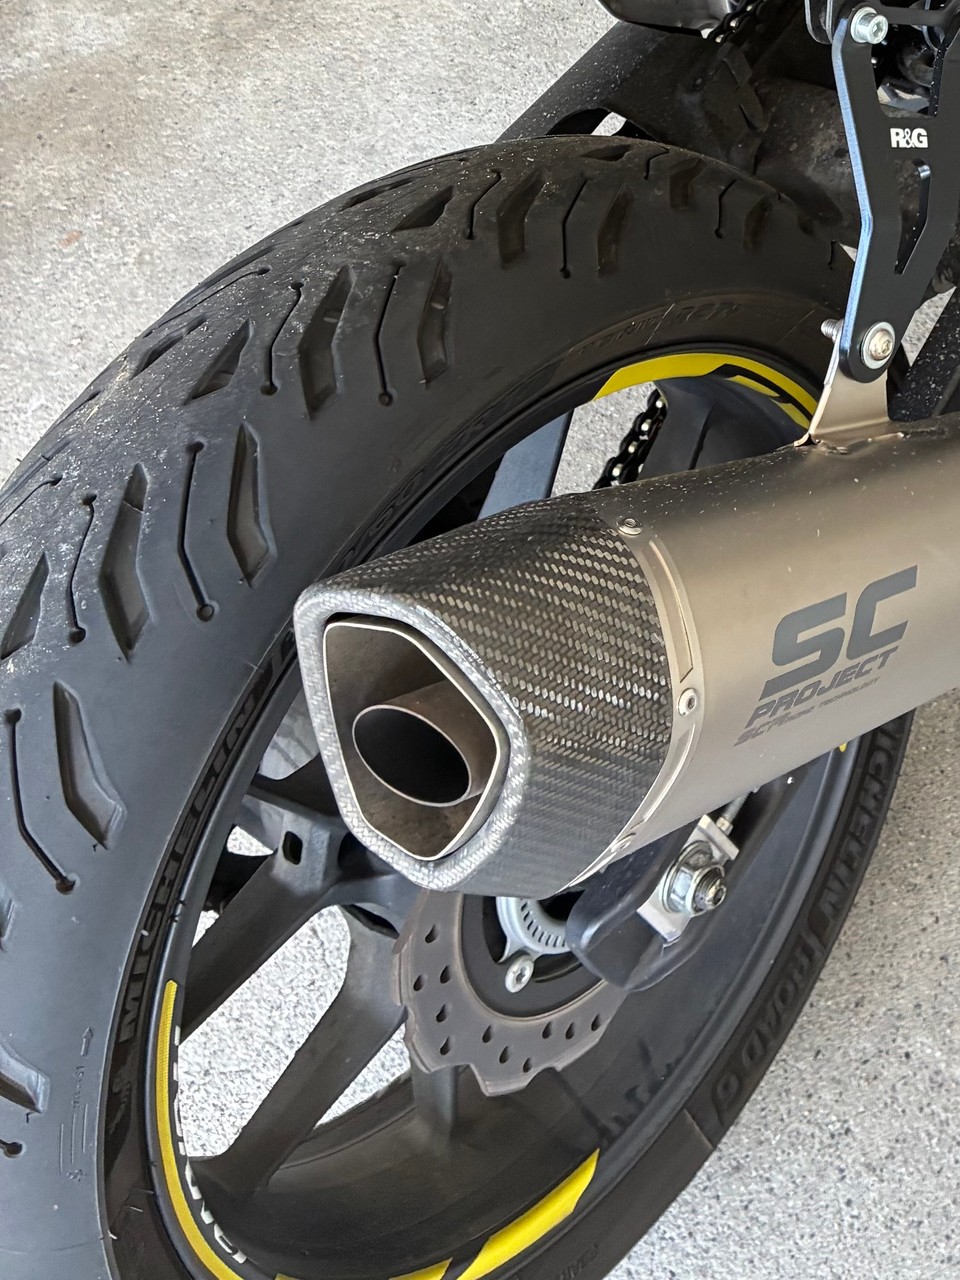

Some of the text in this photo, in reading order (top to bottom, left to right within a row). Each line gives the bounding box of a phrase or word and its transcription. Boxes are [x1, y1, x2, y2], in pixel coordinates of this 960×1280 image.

[890, 127, 929, 148] R&G
[758, 564, 918, 702] SC
[744, 645, 899, 729] PROJECT
